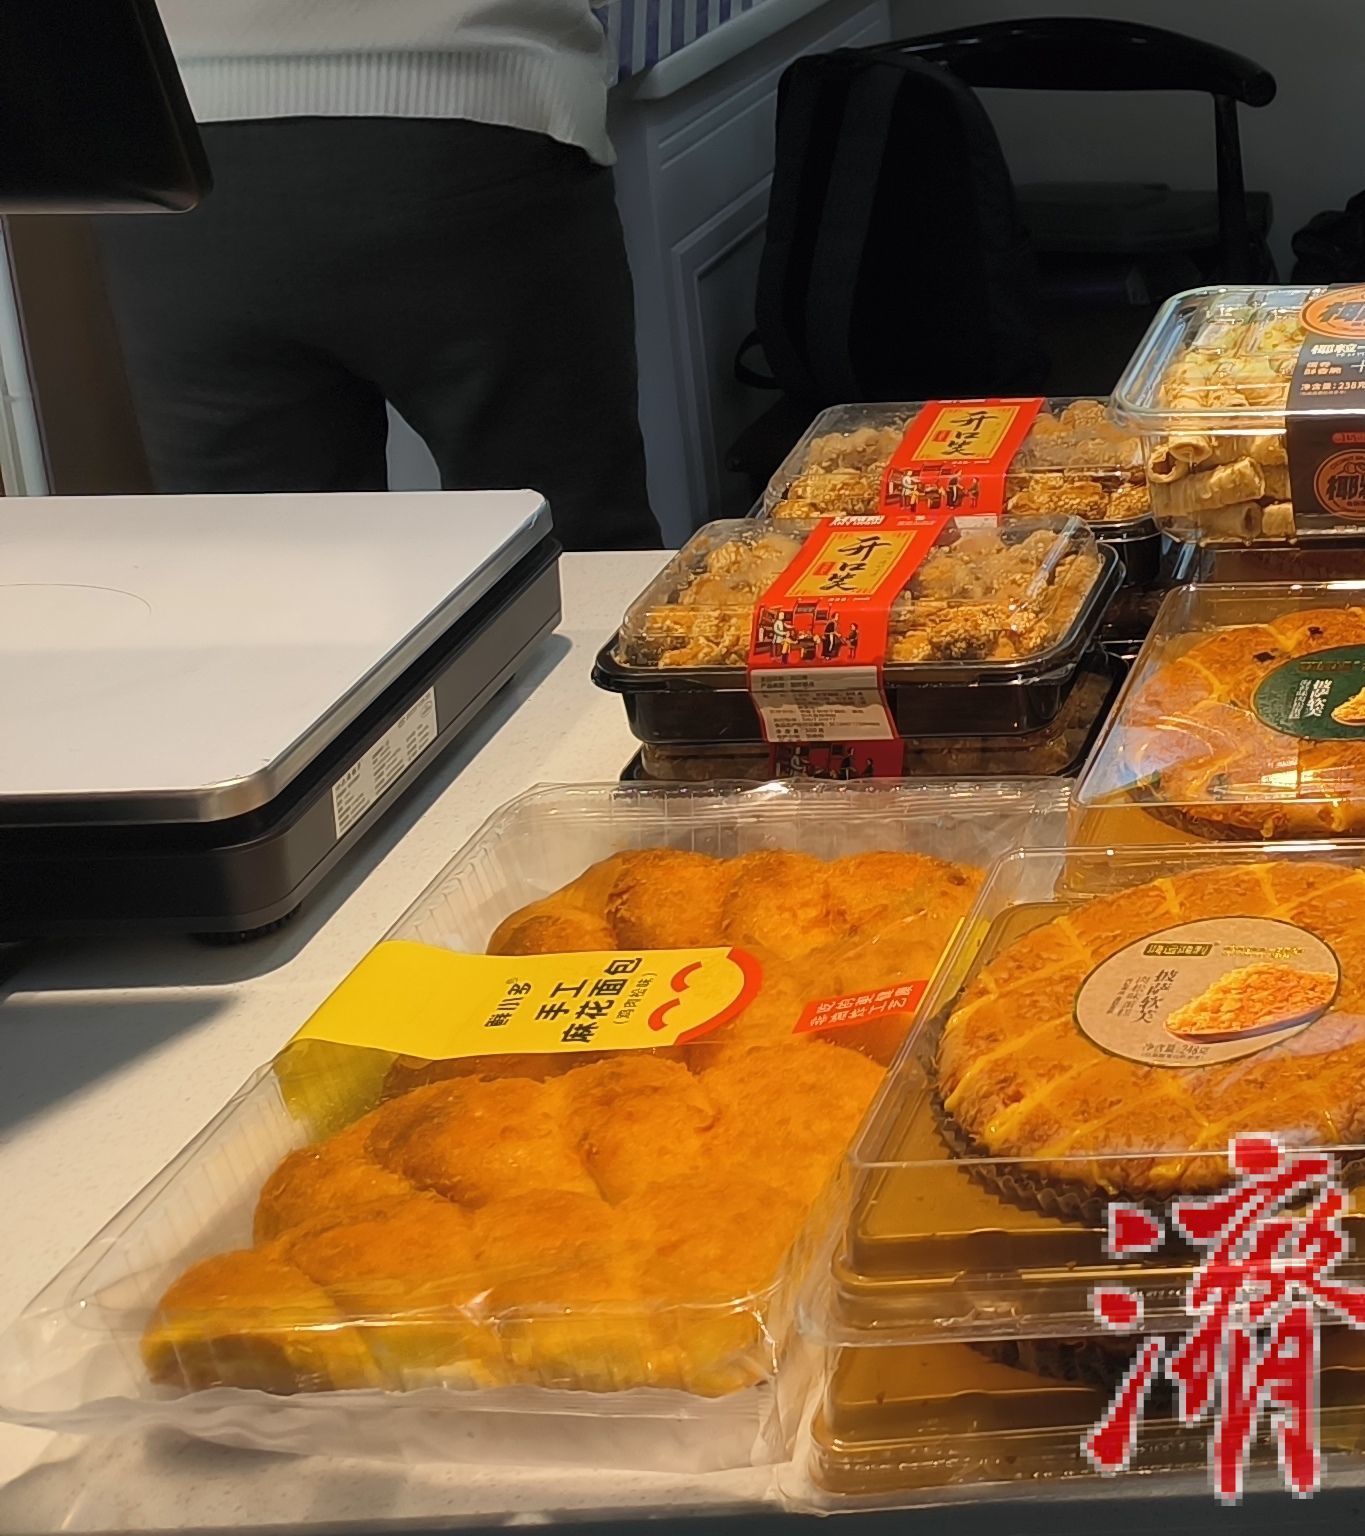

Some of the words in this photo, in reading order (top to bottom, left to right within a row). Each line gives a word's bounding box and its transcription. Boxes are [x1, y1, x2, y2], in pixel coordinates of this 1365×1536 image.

[535, 979, 589, 1022] 手工
[560, 957, 643, 1044] 麻花面包
